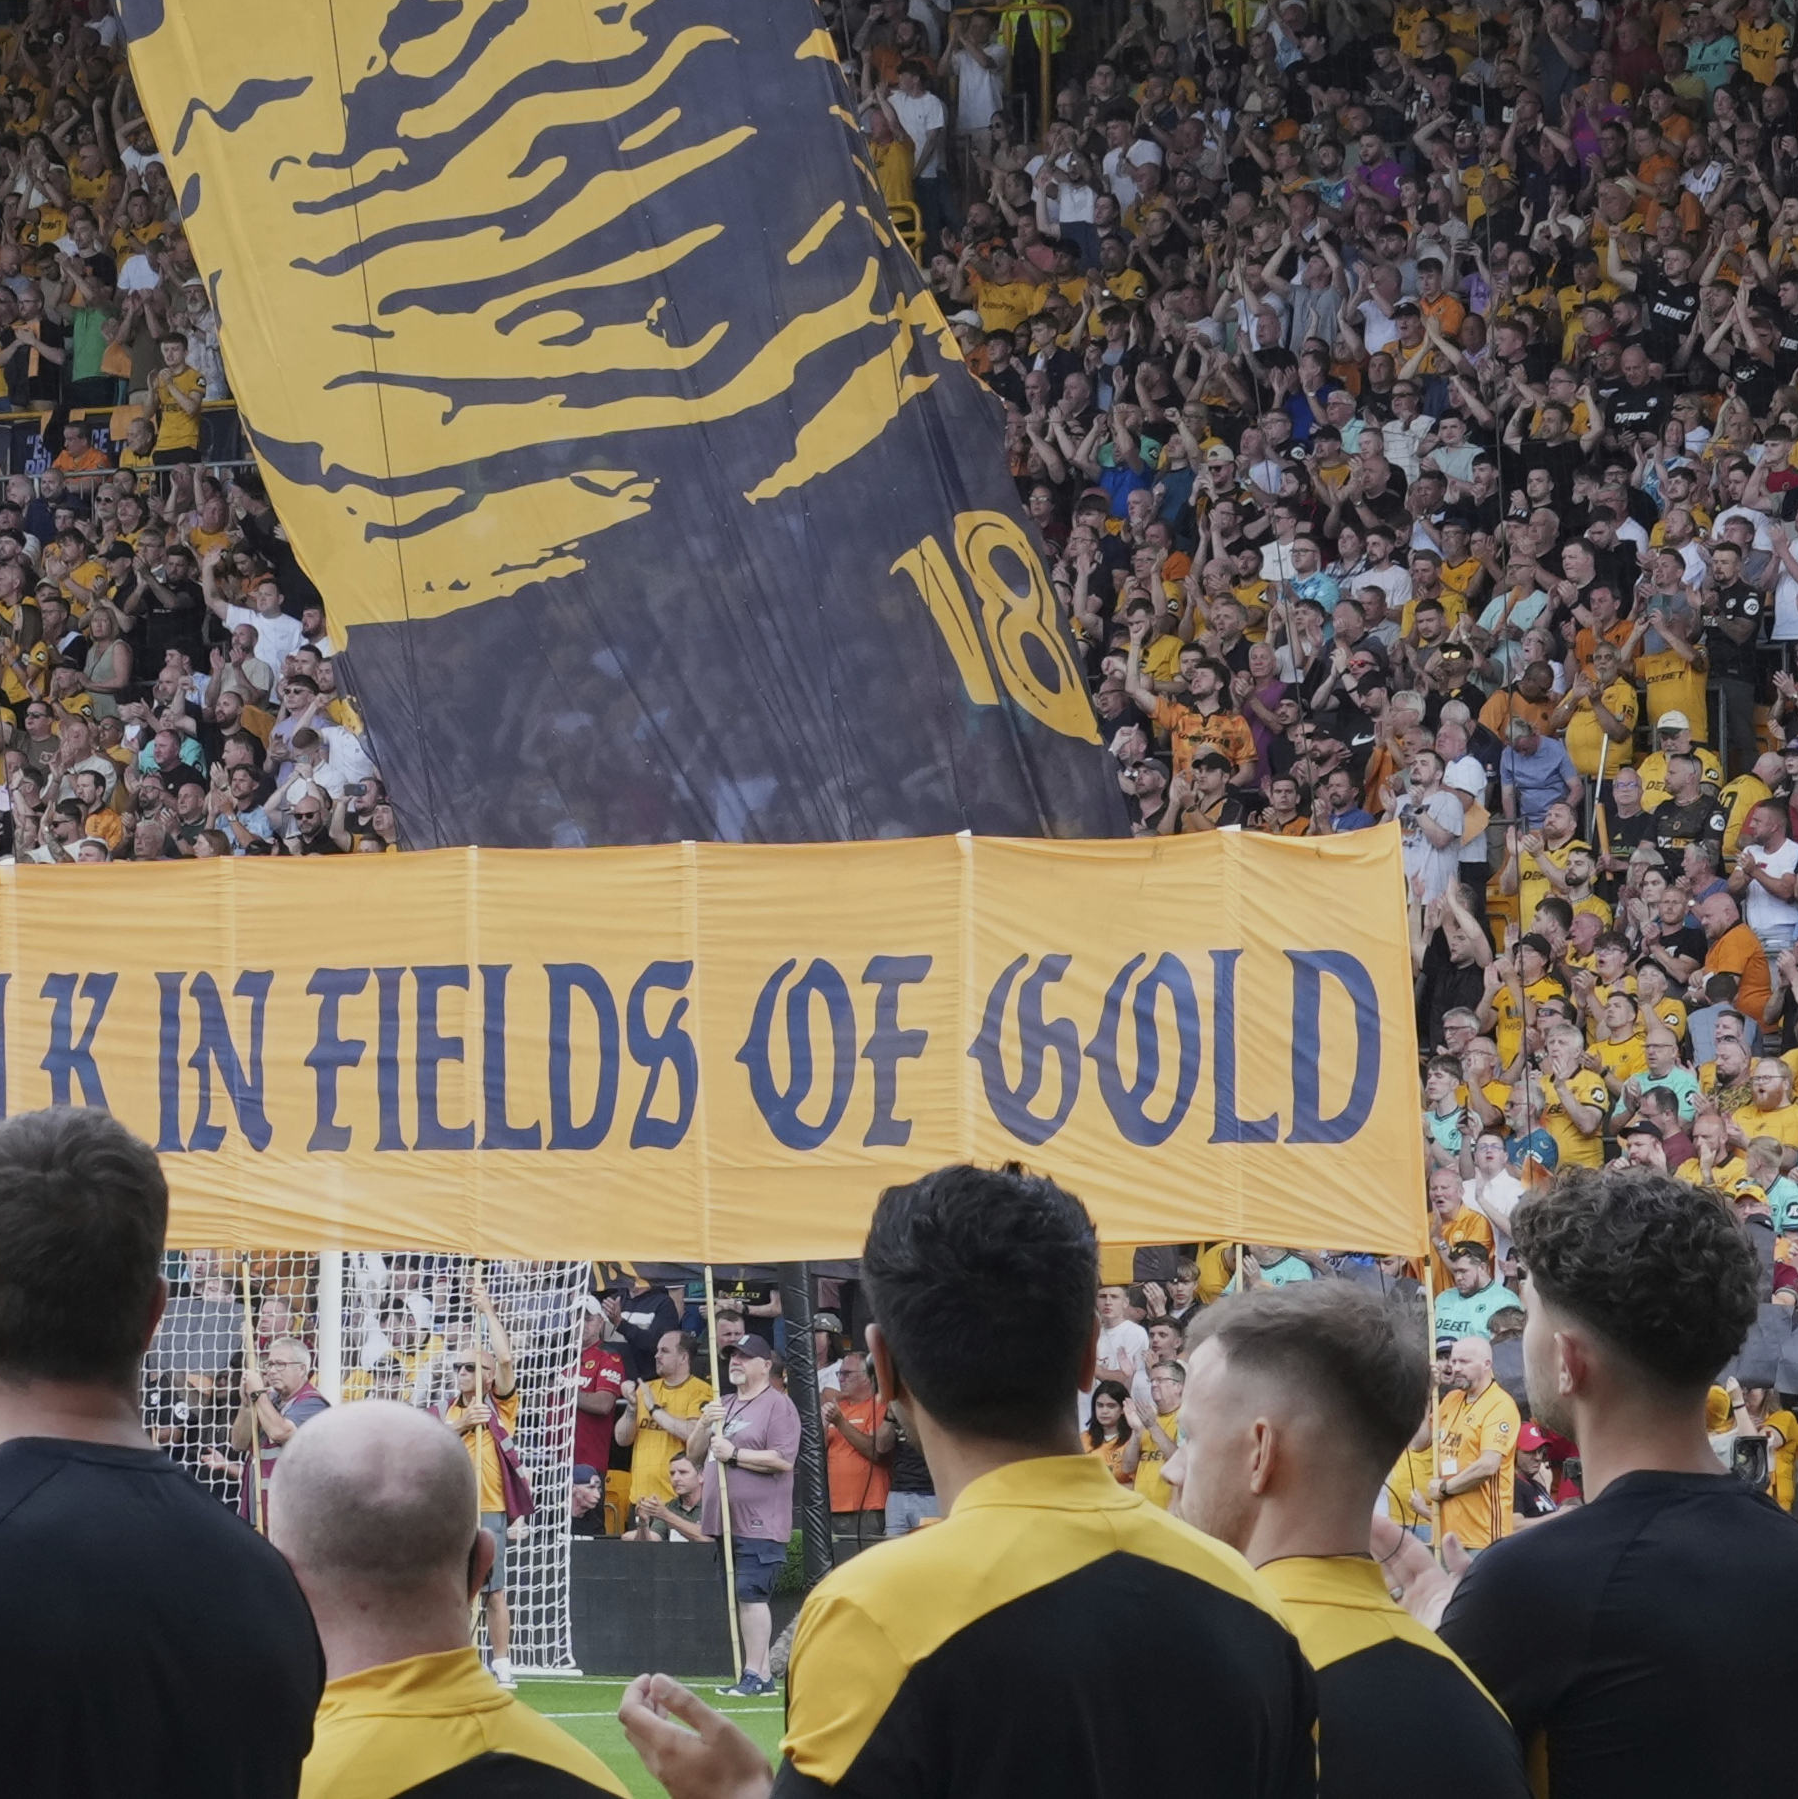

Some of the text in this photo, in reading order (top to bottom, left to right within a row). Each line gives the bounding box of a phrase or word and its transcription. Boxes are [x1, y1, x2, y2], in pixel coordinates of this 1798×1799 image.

[1653, 302, 1692, 321] DEBET
[1613, 411, 1651, 424] DEBET
[889, 509, 1104, 746] 18
[1646, 670, 1686, 685] DEBET
[155, 969, 275, 1153] IN
[305, 959, 699, 1151] FIELDS
[735, 954, 933, 1151] OF
[967, 948, 1381, 1146] GOLD
[1436, 1320, 1470, 1333] DEBET
